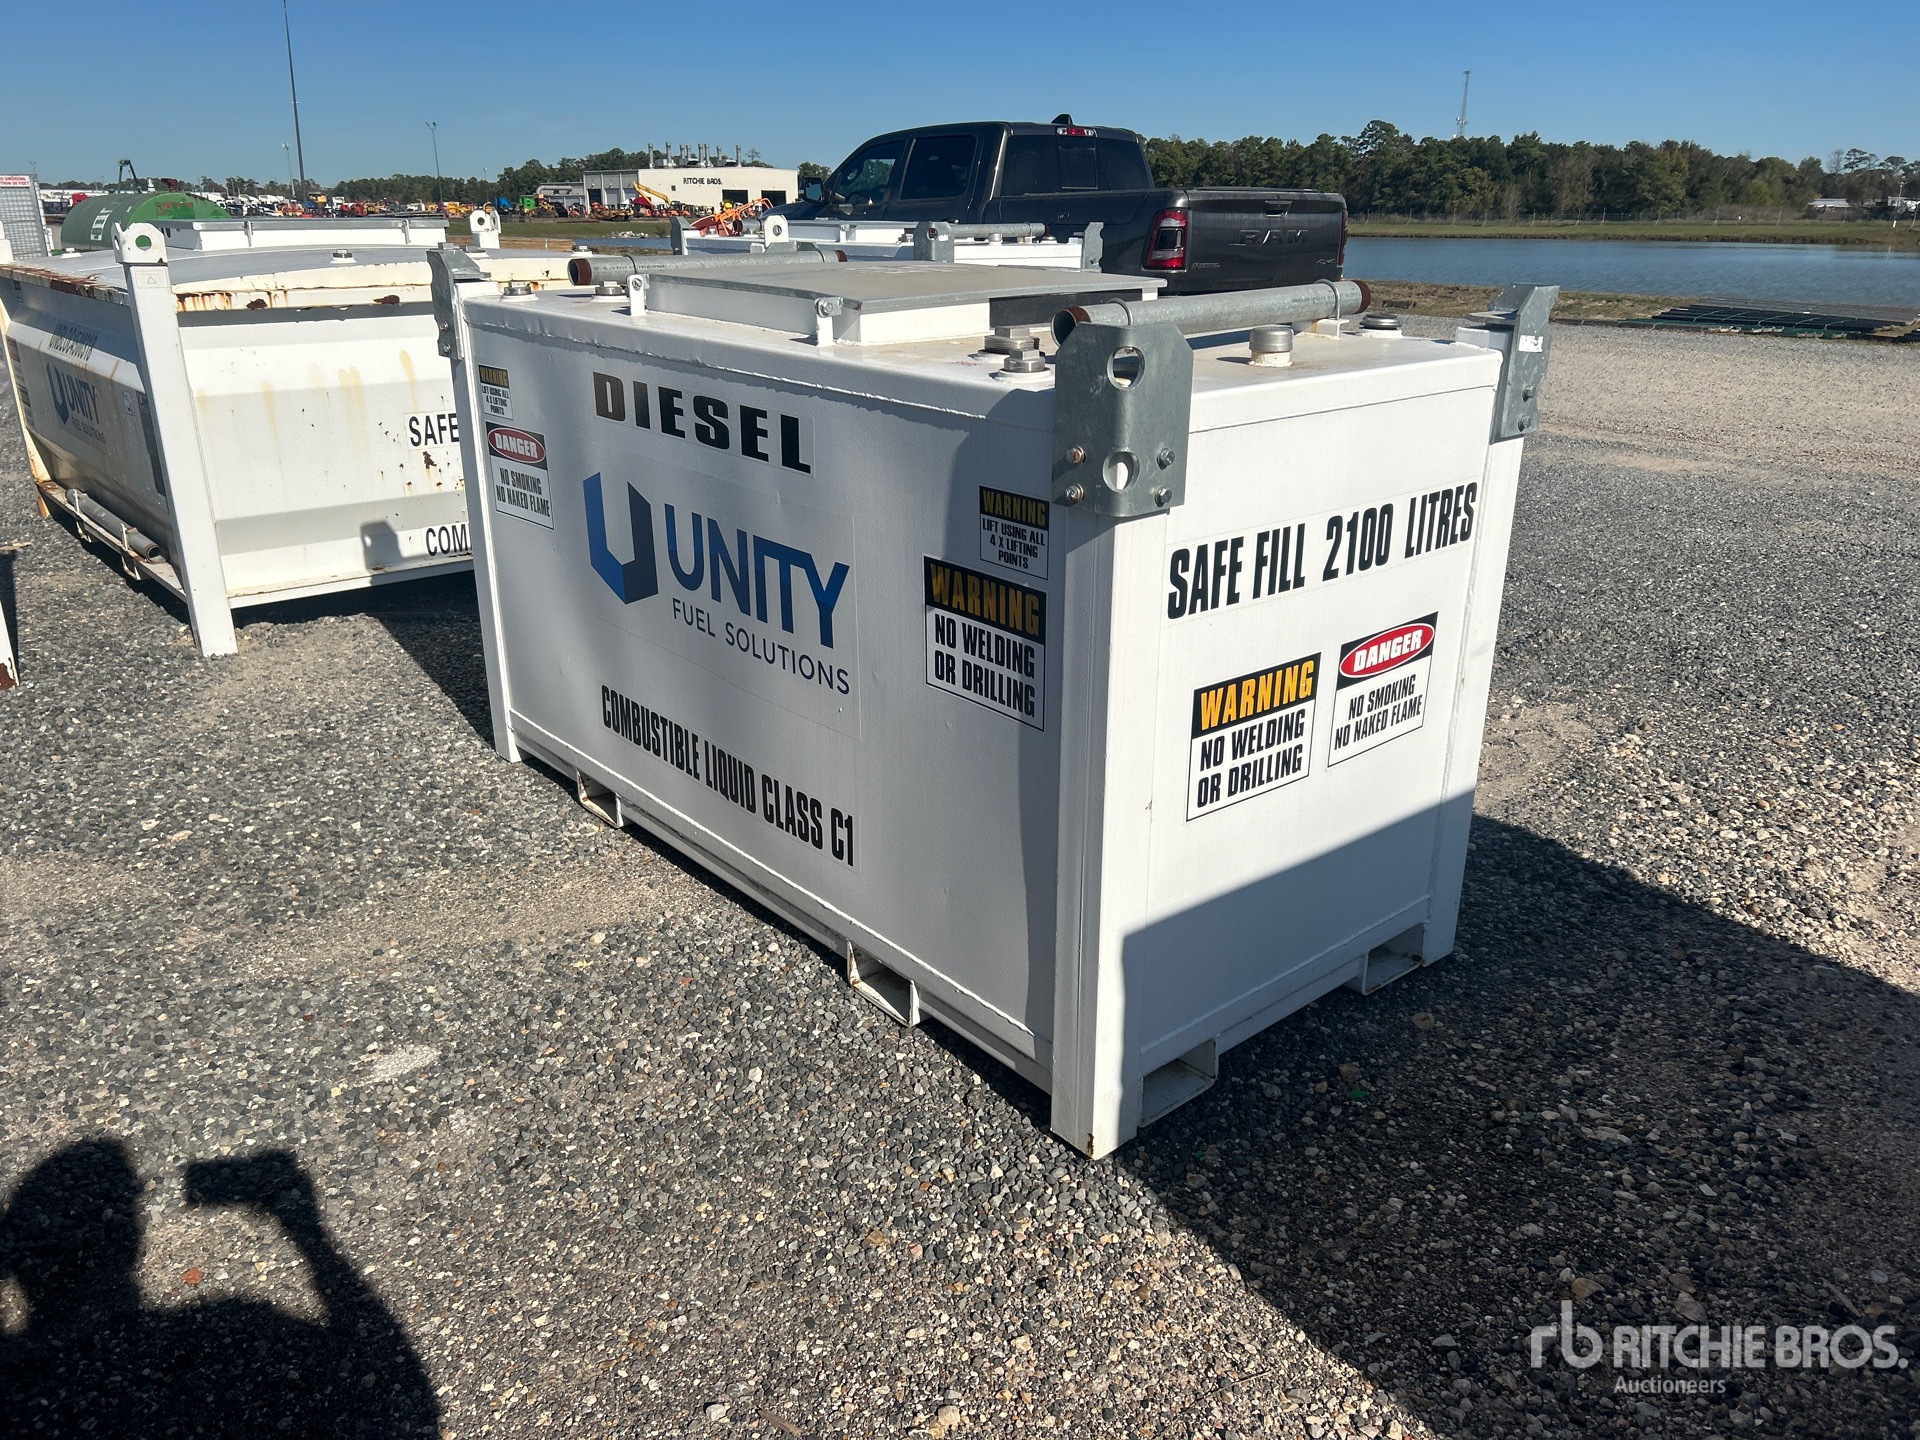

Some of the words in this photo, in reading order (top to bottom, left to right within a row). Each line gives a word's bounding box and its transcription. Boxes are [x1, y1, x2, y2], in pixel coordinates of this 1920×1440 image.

[683, 177, 705, 185] RITCHIE
[1239, 229, 1308, 246] RAM
[62, 372, 99, 424] UNITY
[409, 413, 460, 447] SAFE
[494, 432, 538, 458] DANGER
[593, 372, 811, 474] DIESEL
[496, 485, 506, 502] NO
[507, 488, 528, 510] NAKED
[530, 495, 550, 517] FLAME
[500, 468, 510, 486] NO
[510, 471, 542, 495] SMOKING
[982, 489, 1046, 526] WARNING
[982, 518, 998, 533] LIFT
[1001, 523, 1027, 541] USING
[1030, 531, 1045, 546] ALL
[426, 524, 472, 557] COM
[990, 534, 996, 546] 4
[999, 536, 1004, 549] X
[1006, 538, 1038, 558] LIFTING
[998, 550, 1028, 569] POINTS
[1167, 536, 1244, 620] SAFE
[1252, 523, 1306, 600] FILL
[1322, 503, 1394, 582] 2100
[1404, 482, 1478, 559] LITRES
[664, 503, 850, 649] UNITY
[930, 563, 1040, 637] WARNING
[672, 598, 716, 638] FUEL
[726, 622, 850, 695] SOLUTIONS
[935, 614, 956, 649] NO
[962, 622, 1035, 679] WELDING
[1353, 628, 1424, 673] DANGER
[935, 650, 956, 686] OR
[962, 659, 1035, 718] DRILLING
[1200, 660, 1315, 731] WARNING
[1348, 694, 1364, 721] NO
[1367, 674, 1416, 713] SMOKING
[1200, 736, 1225, 772] NO
[1232, 708, 1306, 761] WELDING
[1334, 724, 1350, 750] NO
[1354, 708, 1388, 742] NAKED
[1390, 694, 1423, 726] FLAME
[601, 684, 700, 781] COMBUSTIBLE
[704, 740, 756, 814] LIQUID
[762, 774, 823, 850] CLASS
[831, 808, 854, 867] C1
[1197, 772, 1222, 808] OR
[1228, 744, 1303, 798] DRILLING
